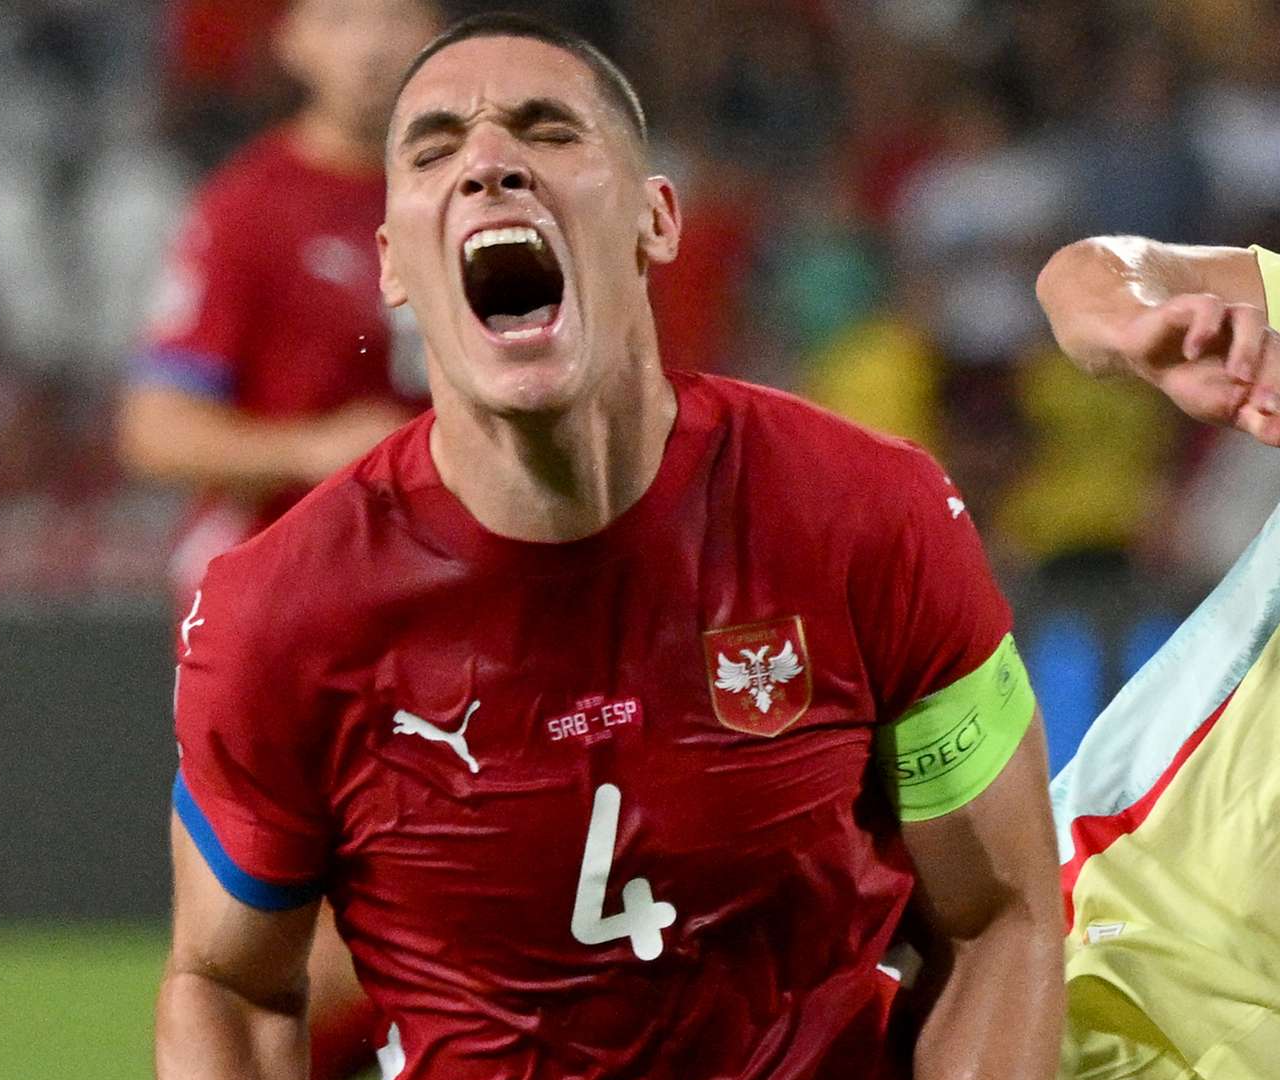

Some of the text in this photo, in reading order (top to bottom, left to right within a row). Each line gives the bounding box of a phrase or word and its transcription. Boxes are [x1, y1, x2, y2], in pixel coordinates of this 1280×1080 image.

[547, 712, 589, 741] SRB
[601, 700, 637, 727] ESP
[895, 712, 982, 781] SPECT
[570, 783, 677, 961] 4
